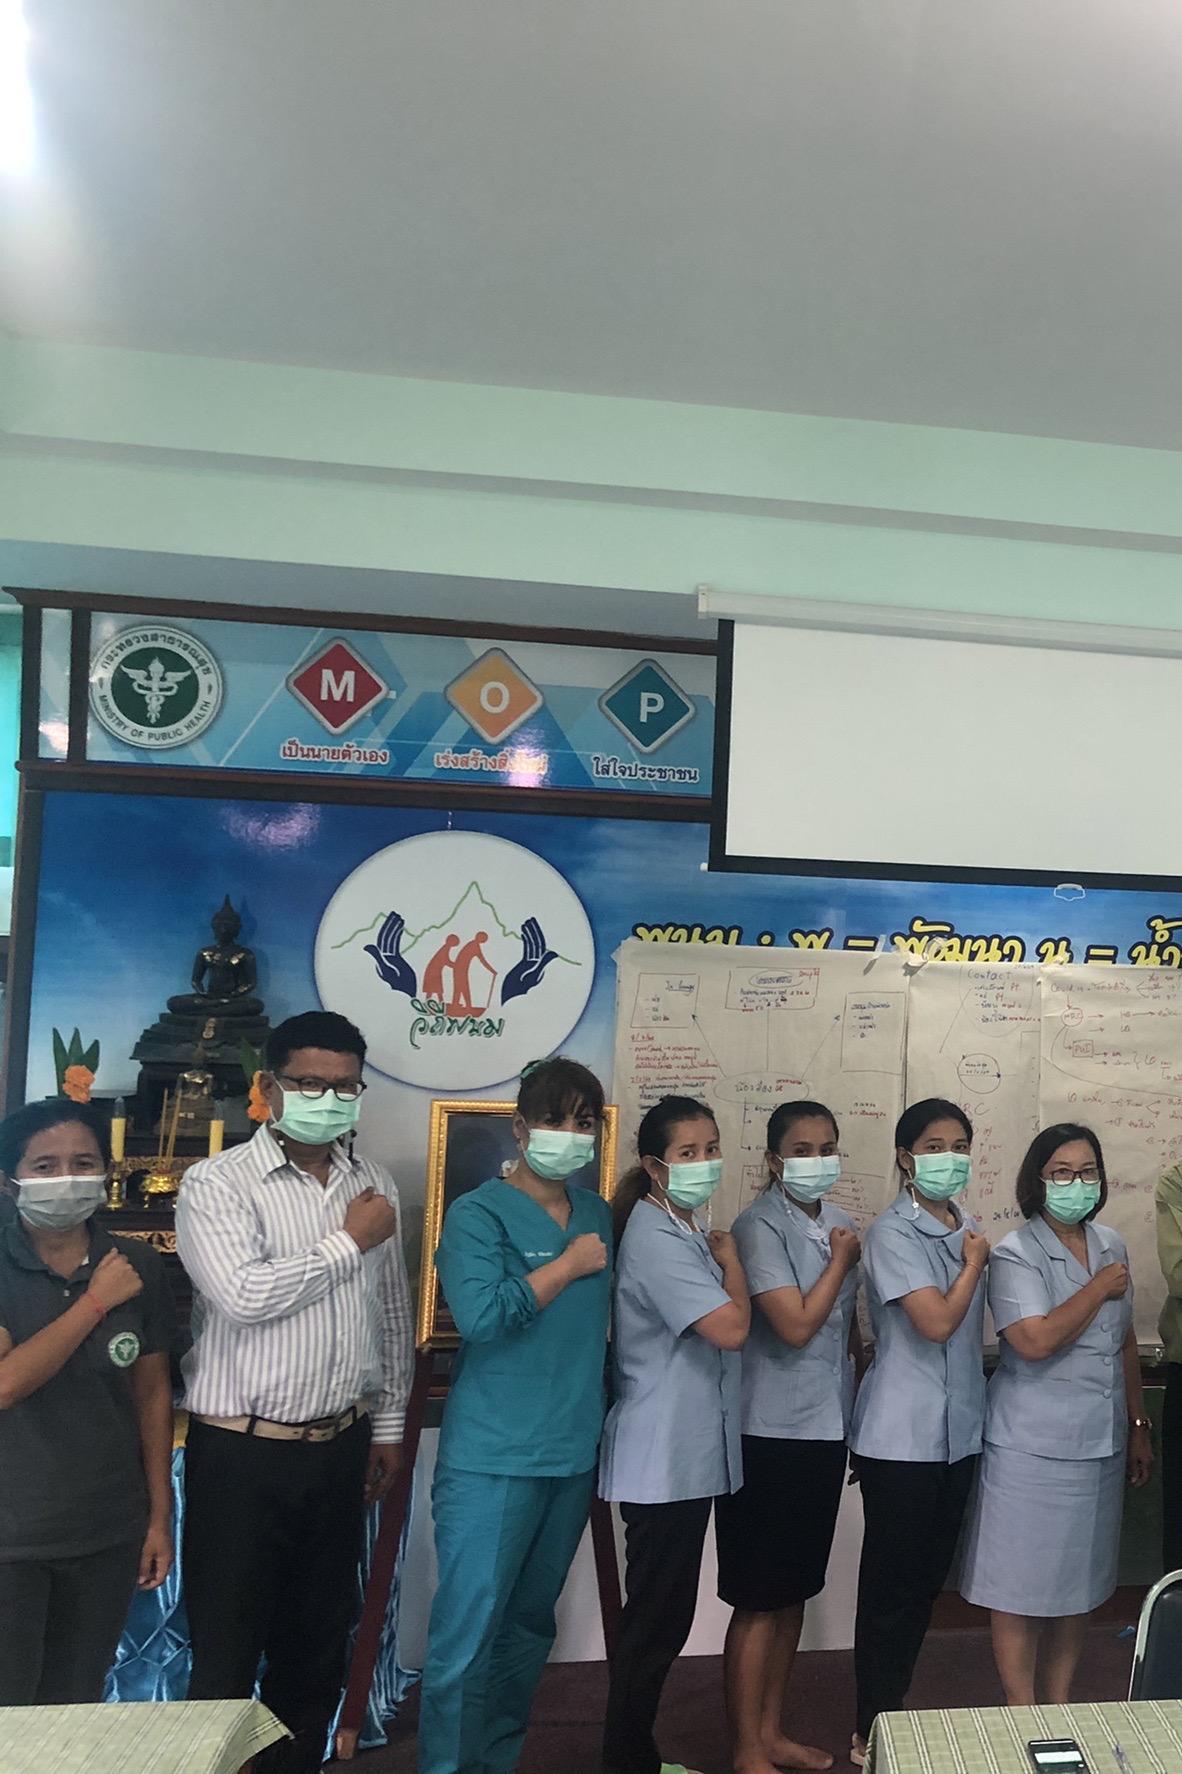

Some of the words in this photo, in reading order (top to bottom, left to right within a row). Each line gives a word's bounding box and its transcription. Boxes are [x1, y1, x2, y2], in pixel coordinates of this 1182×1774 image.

[320, 668, 355, 702] M
[480, 681, 510, 714] O
[99, 694, 129, 732] MINISTRY
[131, 728, 145, 738] OF
[147, 728, 184, 741] PUBLIC
[185, 700, 212, 731] HEALTH
[640, 692, 664, 722] P
[282, 739, 388, 763] เป็นนายตัวเอง
[593, 756, 698, 781] ใส่ใจประชาชน
[967, 968, 1013, 981] Contact
